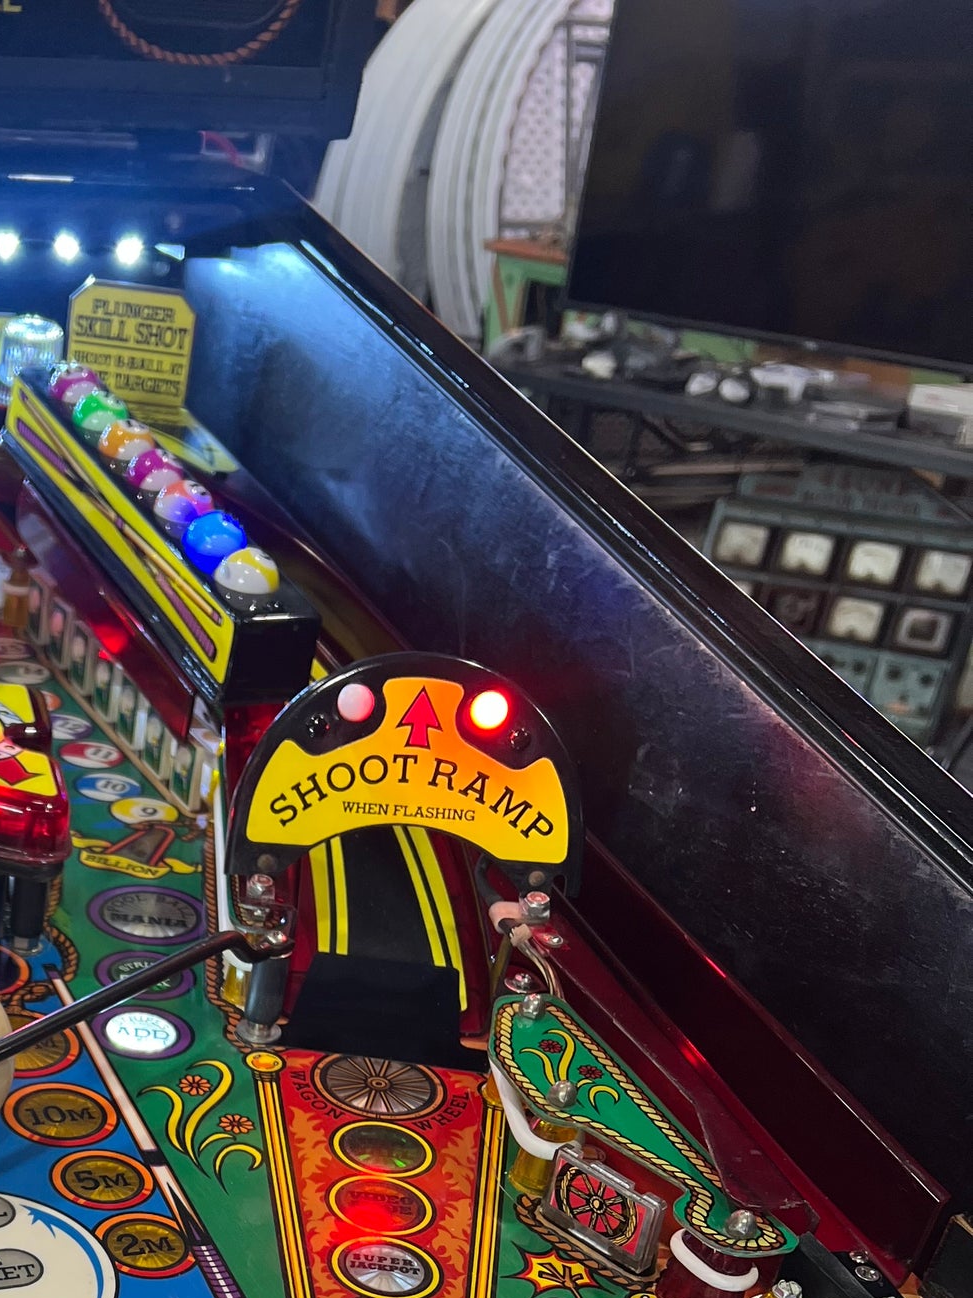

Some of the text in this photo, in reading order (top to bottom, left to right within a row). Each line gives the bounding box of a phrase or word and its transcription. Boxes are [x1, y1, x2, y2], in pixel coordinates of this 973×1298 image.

[75, 315, 189, 350] SKILL SHOT
[102, 781, 127, 793] 10
[269, 754, 555, 839] SHOOT RAMP
[141, 806, 159, 818] 9
[342, 800, 476, 822] WHEN FLASHING
[84, 854, 160, 877] BILLION
[111, 912, 189, 929] MANIA
[118, 1026, 171, 1041] ADD
[293, 1070, 470, 1132] WAGON WHEEL
[24, 1105, 97, 1127] 10M
[73, 1167, 130, 1193] 5M
[115, 1230, 176, 1260] 2M
[350, 1260, 420, 1276] JACKPOT
[353, 1253, 415, 1267] SUPER
